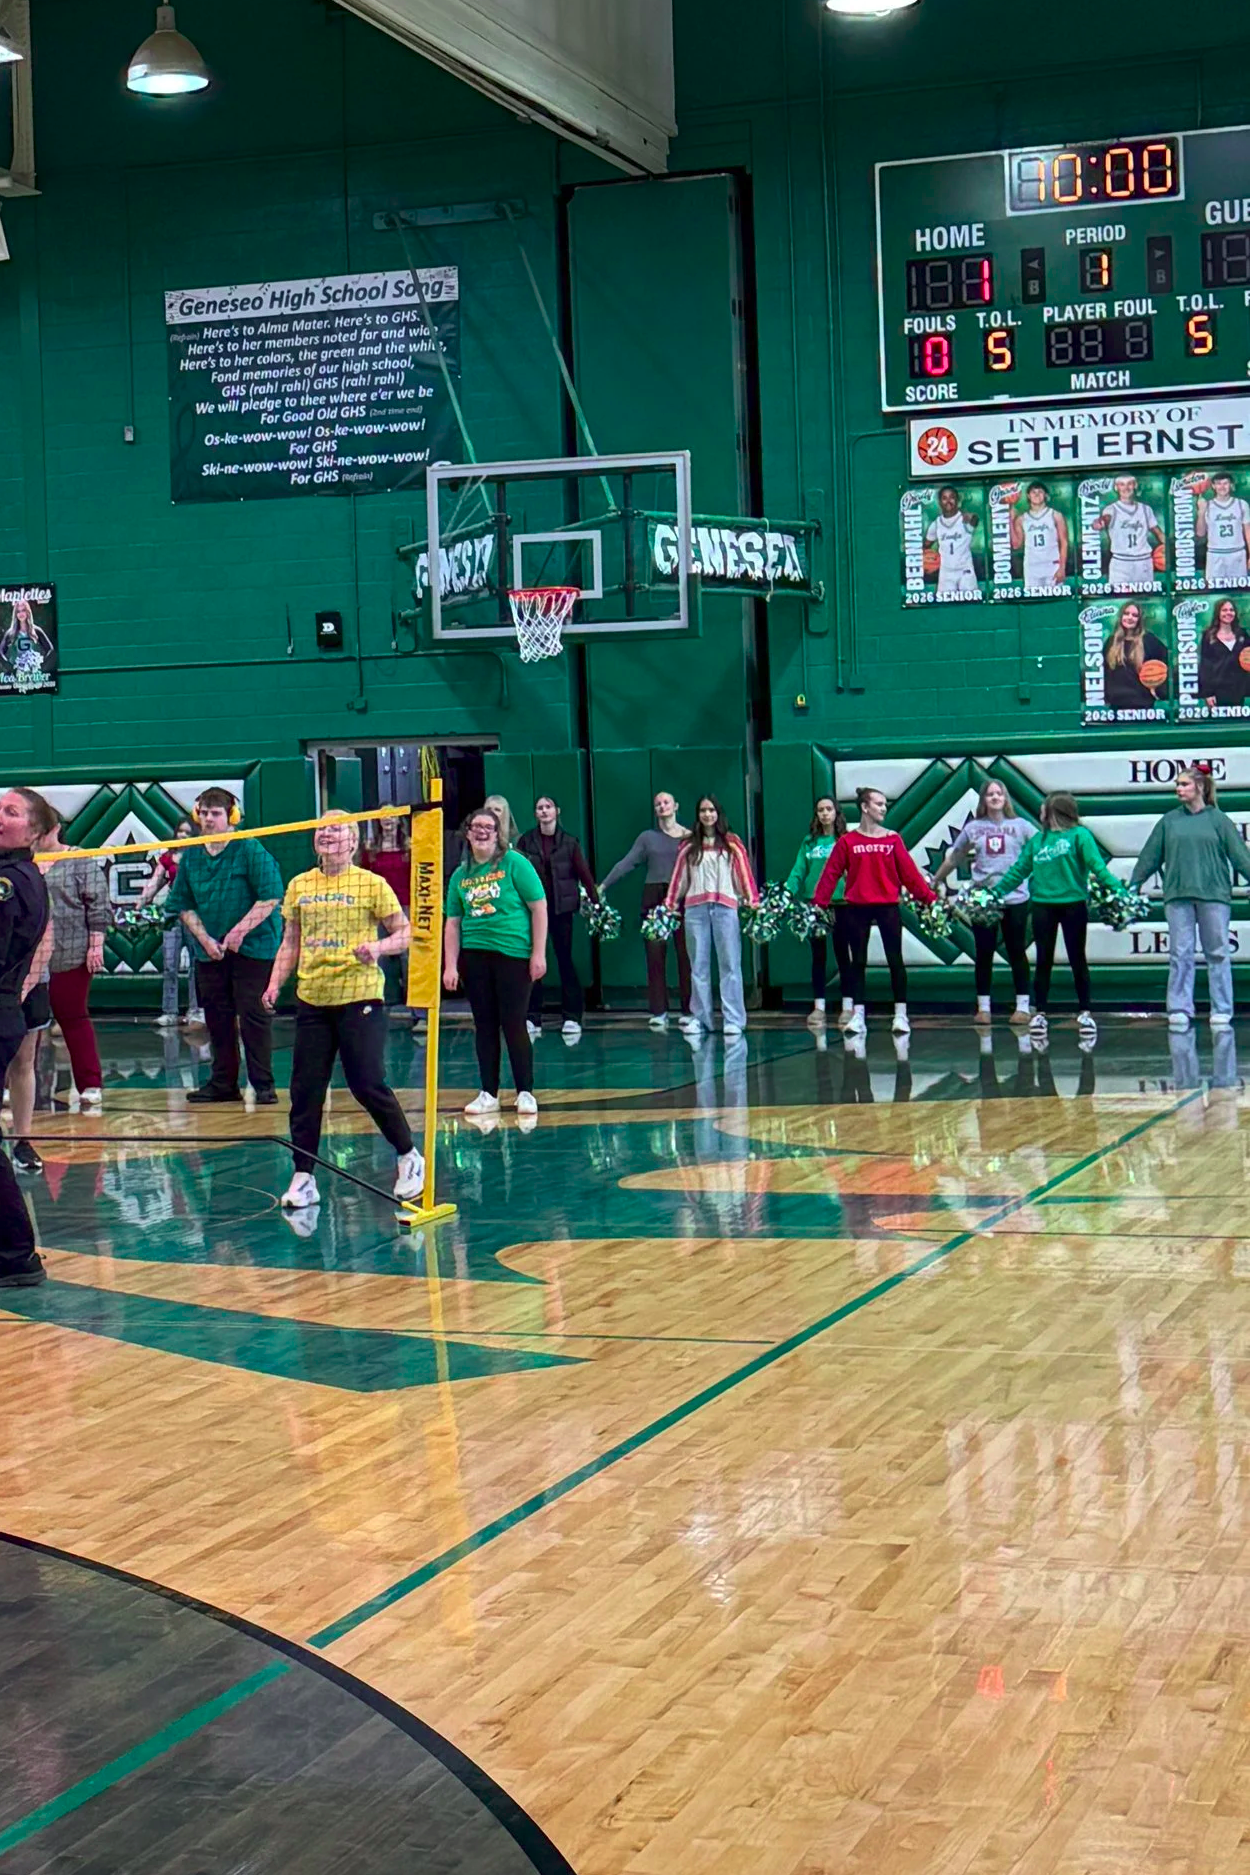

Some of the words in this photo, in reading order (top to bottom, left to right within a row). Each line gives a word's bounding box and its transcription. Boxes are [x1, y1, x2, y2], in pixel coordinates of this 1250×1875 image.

[1037, 144, 1173, 203] 10:00
[915, 223, 986, 252] HOME
[1065, 225, 1126, 245] PERIOD
[178, 295, 265, 317] Geneseo
[268, 287, 316, 312] High
[320, 280, 388, 304] School
[1176, 293, 1225, 312] T.O.L.
[976, 310, 1022, 328] T.O.L.
[1043, 302, 1107, 323] PLAYER
[1113, 299, 1157, 318] FOUL
[203, 325, 240, 340] Here's
[243, 325, 254, 336] to
[257, 321, 289, 335] Alma
[292, 318, 331, 331] Mater.
[335, 313, 372, 328] Here's
[376, 313, 388, 324] to
[392, 310, 421, 324] GHS.
[904, 315, 956, 334] FOULS
[1188, 315, 1213, 355] 5
[188, 341, 224, 356] Here's
[227, 341, 239, 352] to
[242, 339, 262, 351] her
[265, 334, 320, 349] members
[323, 330, 357, 344] noted
[359, 328, 379, 343] far
[381, 326, 406, 339] and
[987, 331, 1012, 370] 5
[180, 357, 216, 371] Here's
[219, 358, 231, 369] to
[234, 354, 254, 367] her
[257, 352, 295, 366] colors,
[298, 349, 318, 361] the
[320, 347, 355, 362] green
[358, 342, 382, 356] and
[385, 341, 406, 353] the
[211, 369, 240, 383] Fond
[243, 365, 301, 380] memories
[304, 362, 317, 378] of
[319, 363, 340, 375] our
[342, 358, 369, 374] high
[372, 355, 415, 371] school,
[1070, 370, 1131, 390] MATCH
[222, 384, 247, 397] GHS
[313, 377, 338, 391] GHS
[341, 374, 372, 390] (rah!
[374, 371, 405, 387] rah!)
[905, 383, 959, 402] SCORE
[195, 402, 215, 415] We
[218, 399, 239, 413] will
[241, 398, 282, 415] pledge
[285, 397, 297, 408] to
[300, 393, 327, 407] thee
[330, 391, 367, 405] where
[370, 388, 395, 401] e'er
[396, 388, 415, 399] we
[418, 385, 434, 398] be
[260, 413, 280, 425] For
[282, 408, 314, 423] Good
[317, 407, 338, 420] Old
[340, 405, 366, 419] GHS
[1008, 417, 1036, 433] IN
[1044, 409, 1160, 431] MEMORY
[1166, 406, 1202, 423] OF
[204, 426, 312, 447] Os-ke-wow-wow!
[314, 418, 426, 438] Os-ke-wow-wow!
[289, 442, 310, 455] For
[312, 440, 338, 453] GHS
[926, 435, 950, 458] 24
[967, 434, 1079, 466] SETH
[1097, 424, 1244, 458] ERNST
[201, 456, 313, 477] Ski-ne-wow-wow!
[315, 448, 430, 469] Ski-ne-wow-wow!
[290, 472, 311, 485] For
[313, 470, 339, 484] GHS
[1033, 533, 1045, 547] 13
[1219, 524, 1234, 538] 23
[993, 587, 1022, 600] 2026
[1024, 585, 1072, 598] SENIOR
[1082, 583, 1111, 595] 2026
[1113, 580, 1162, 594] SENIOR
[1175, 579, 1206, 590] 2026
[1207, 576, 1250, 589] SENIO
[905, 591, 935, 604] 2026
[935, 589, 983, 603] SENIOR
[1084, 622, 1105, 707] NELSON
[1177, 616, 1199, 706] PETERSON
[1085, 710, 1115, 721] 2026
[1116, 708, 1166, 721] SENIOR
[1179, 707, 1209, 719] 2026
[853, 842, 894, 855] merry
[418, 861, 434, 931] MAXI-NET
[1130, 929, 1239, 955] LES
